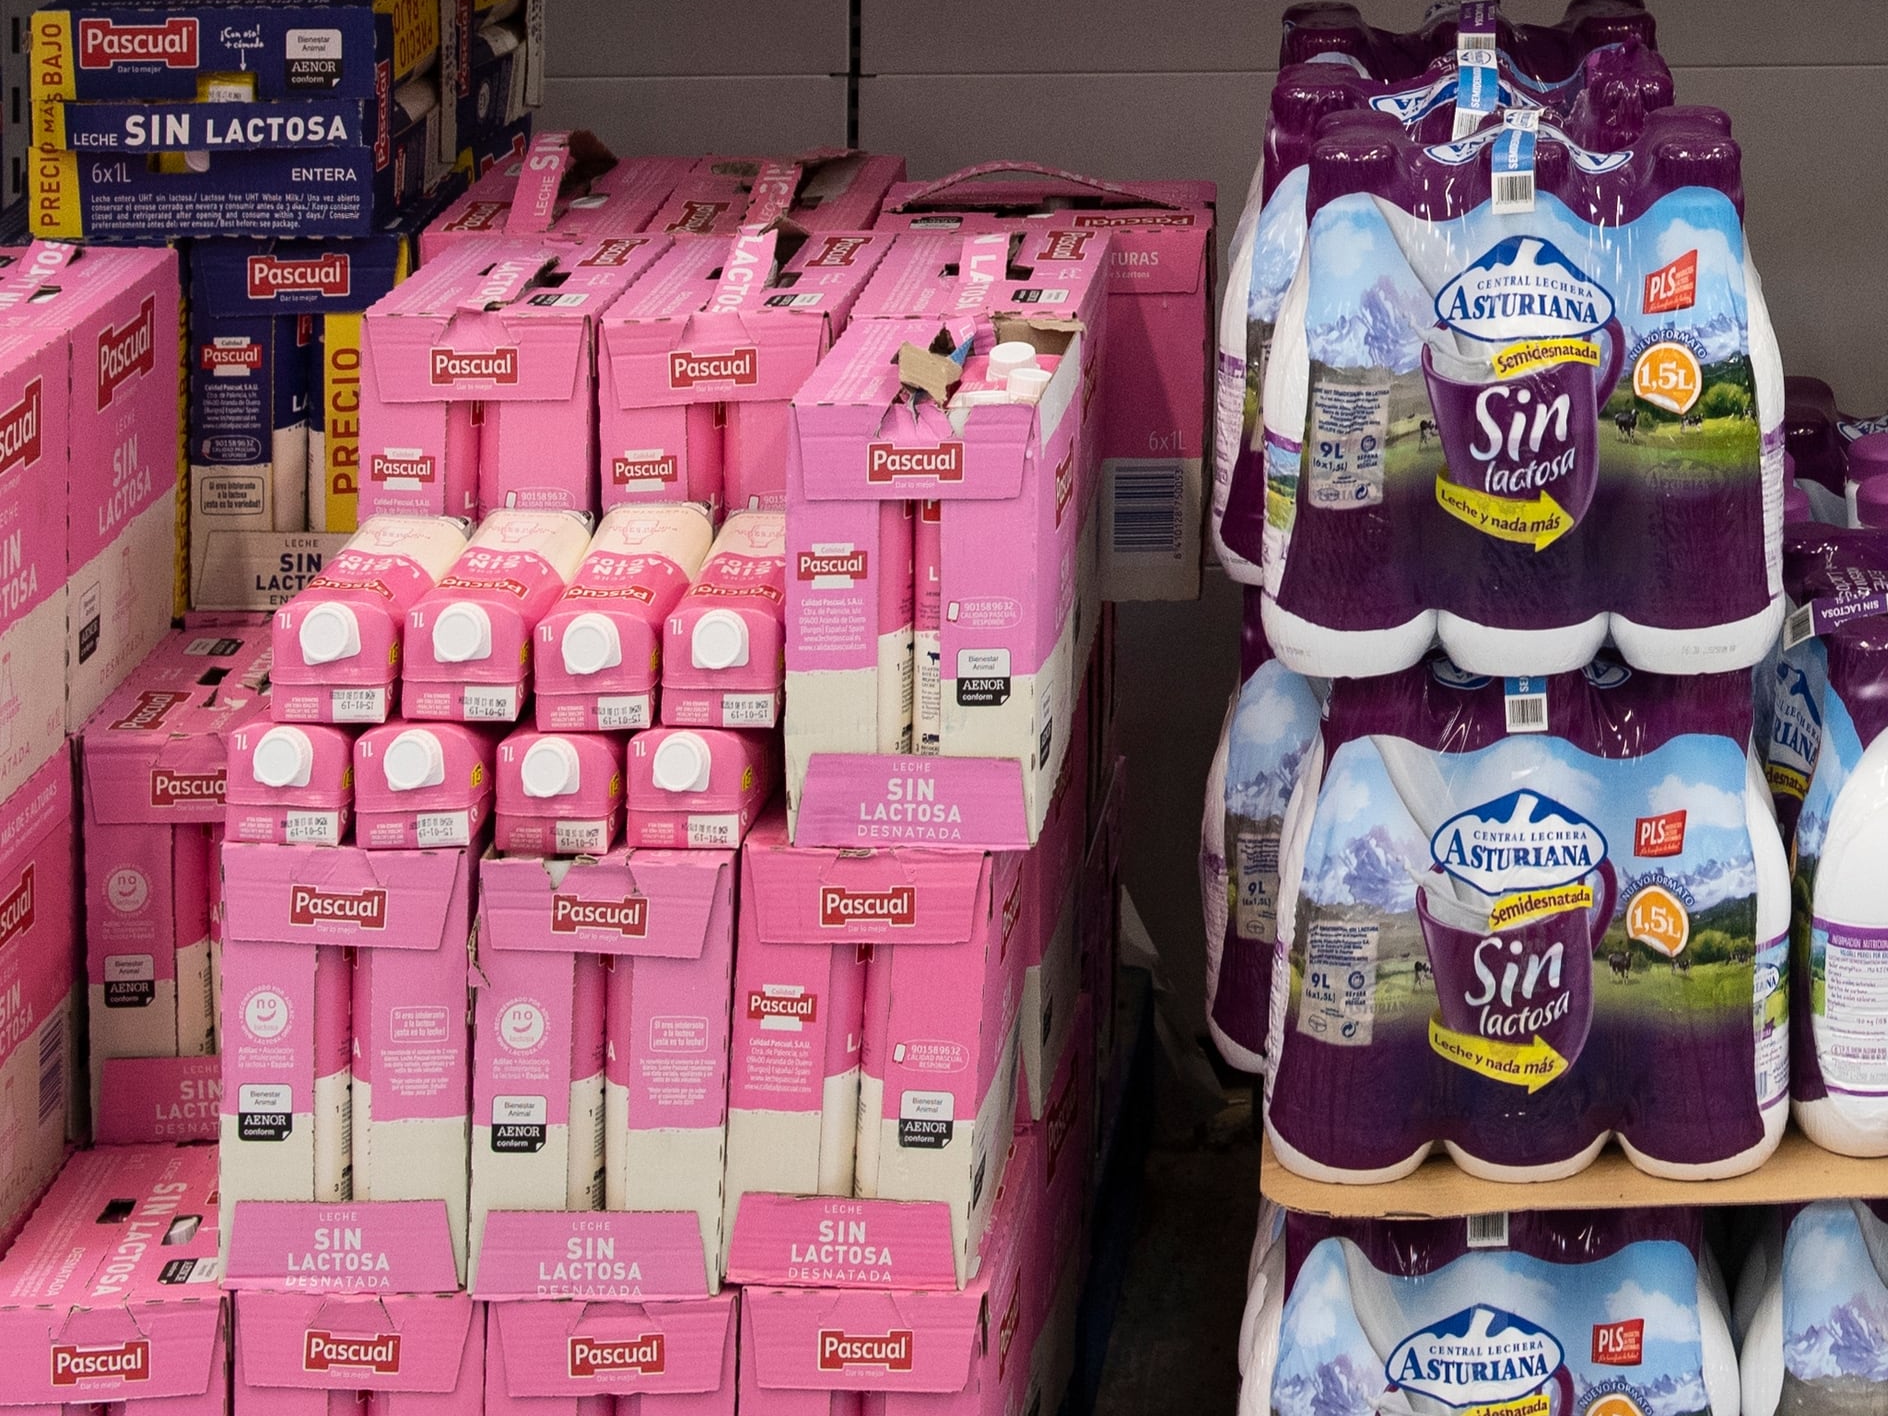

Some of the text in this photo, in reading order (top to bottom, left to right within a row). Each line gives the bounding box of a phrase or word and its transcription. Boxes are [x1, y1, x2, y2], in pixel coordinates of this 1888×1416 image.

[87, 28, 188, 57] Pascual
[74, 116, 347, 146] LECHE SIN LACTOSA
[291, 167, 357, 182] ENTERA
[1477, 275, 1594, 299] CENTRAL LECHERA
[1649, 271, 1675, 300] PLS
[1447, 288, 1598, 324] ASTURIANA
[1497, 347, 1597, 375] Semidesnatada
[1638, 364, 1695, 394] 1,5L
[1471, 387, 1568, 461] Sin
[874, 450, 956, 472] Pascual
[1484, 450, 1574, 493] lactosa
[1440, 491, 1561, 531] Leche y nada más
[963, 679, 1004, 691] AENOR
[893, 762, 931, 772] LECHE
[888, 780, 935, 801] SIN
[860, 804, 961, 824] LACTOSA
[858, 826, 961, 839] DESNATADA
[296, 894, 378, 917] Pascual
[824, 1339, 906, 1359] Pascual
